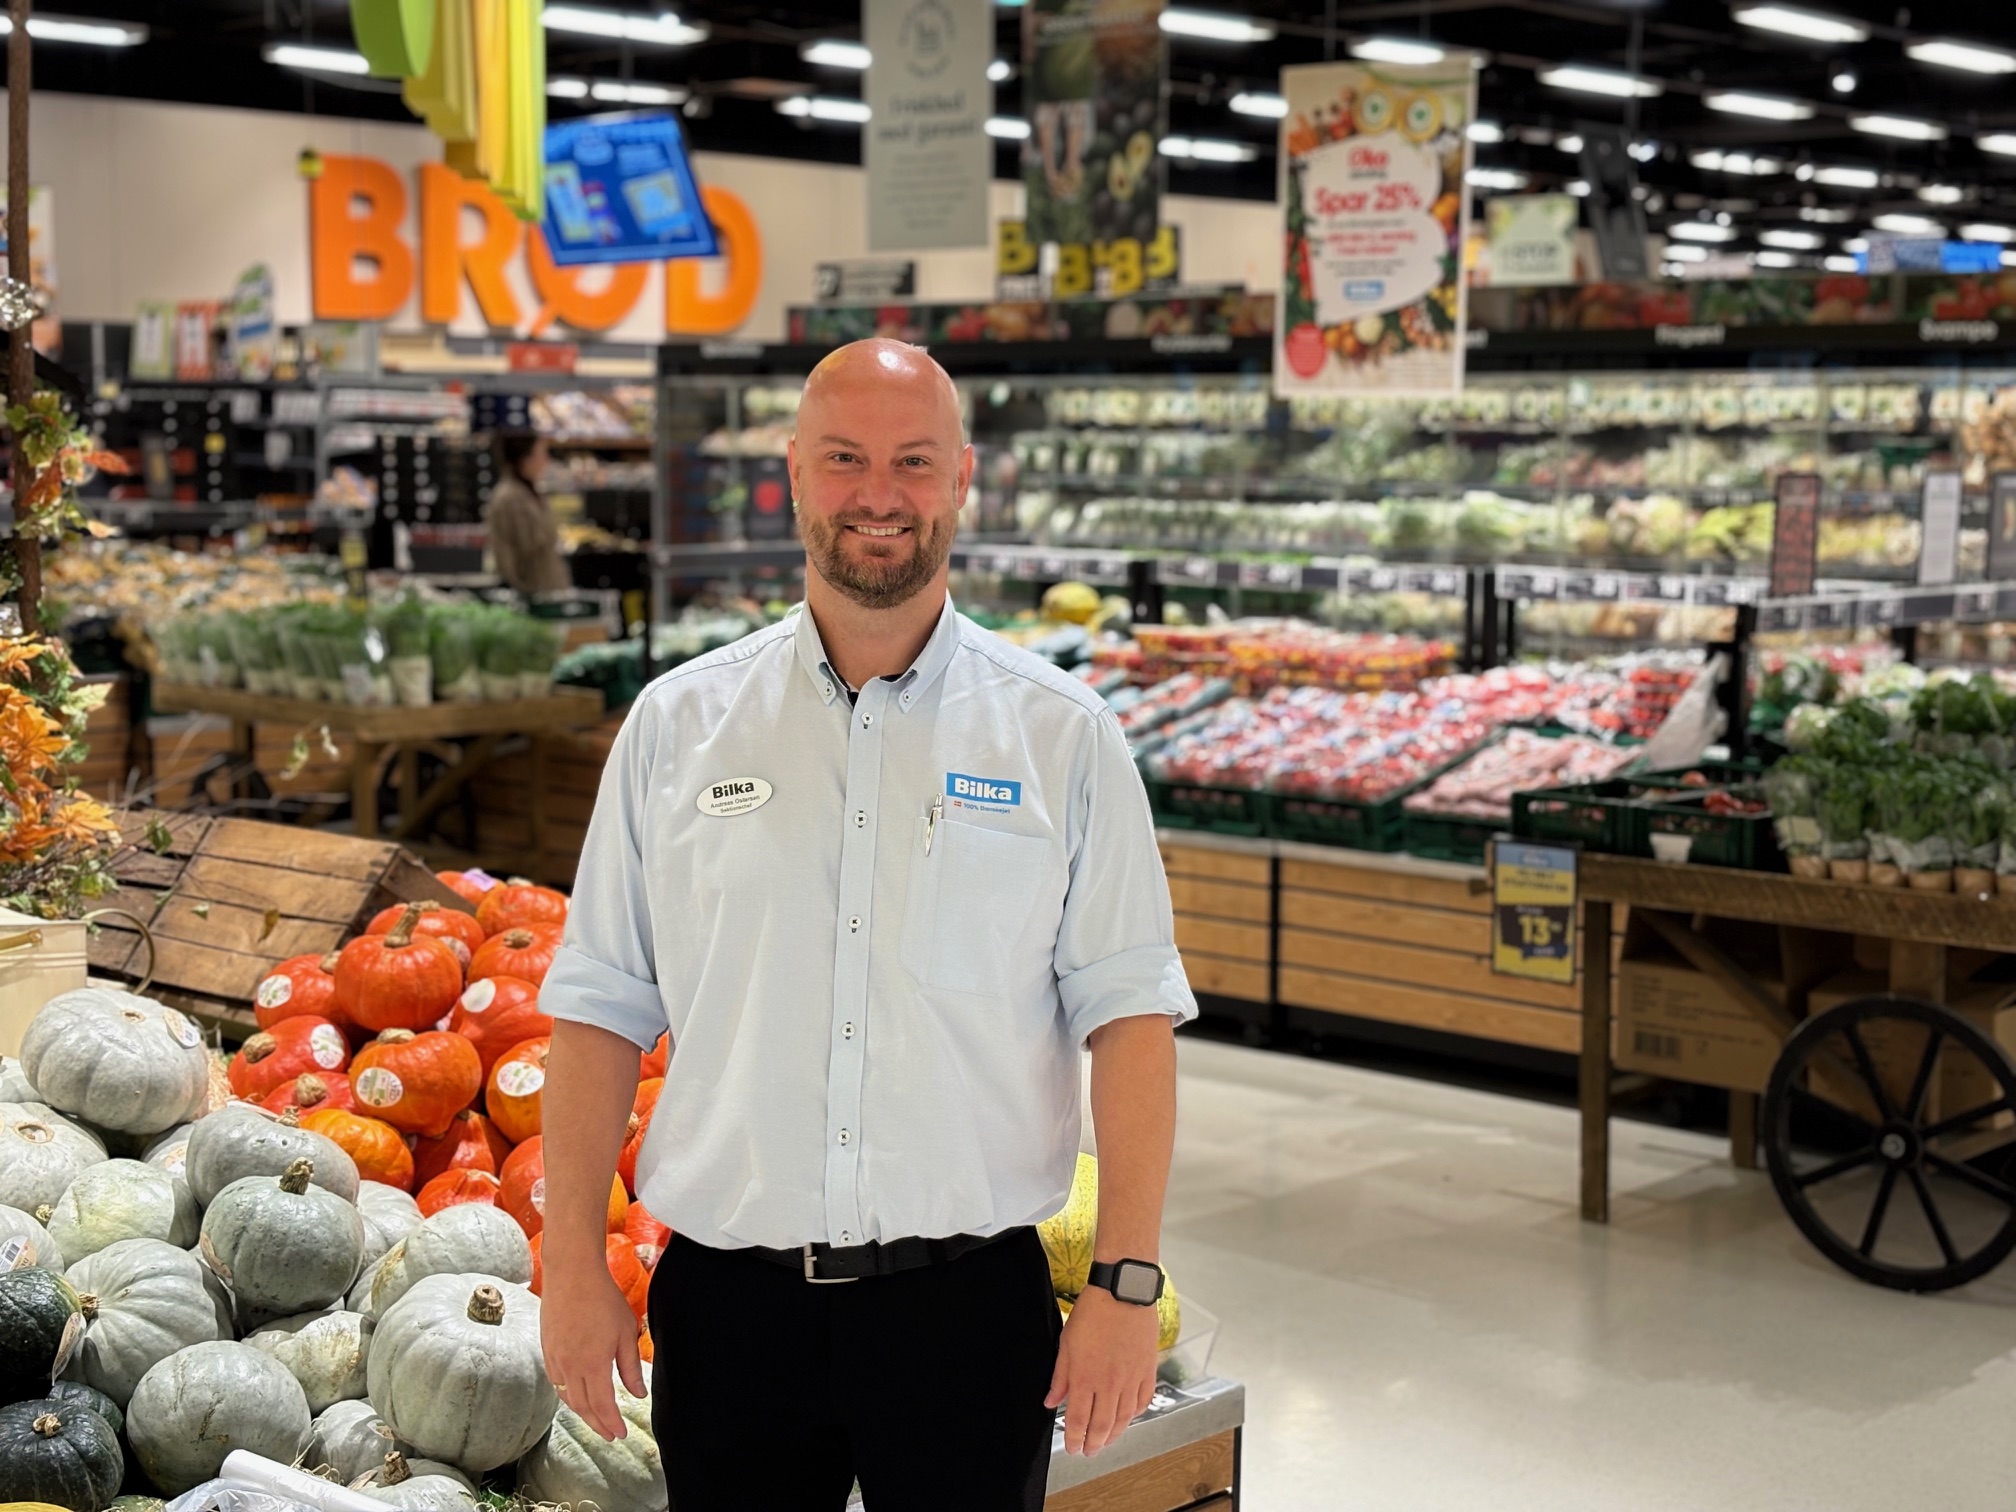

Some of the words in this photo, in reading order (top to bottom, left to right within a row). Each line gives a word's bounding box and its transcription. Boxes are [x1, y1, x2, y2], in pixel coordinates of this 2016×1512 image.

[712, 782, 755, 799] Bilka
[954, 777, 1012, 801] Bilka
[963, 802, 979, 811] 100%
[1518, 914, 1551, 946] 13
